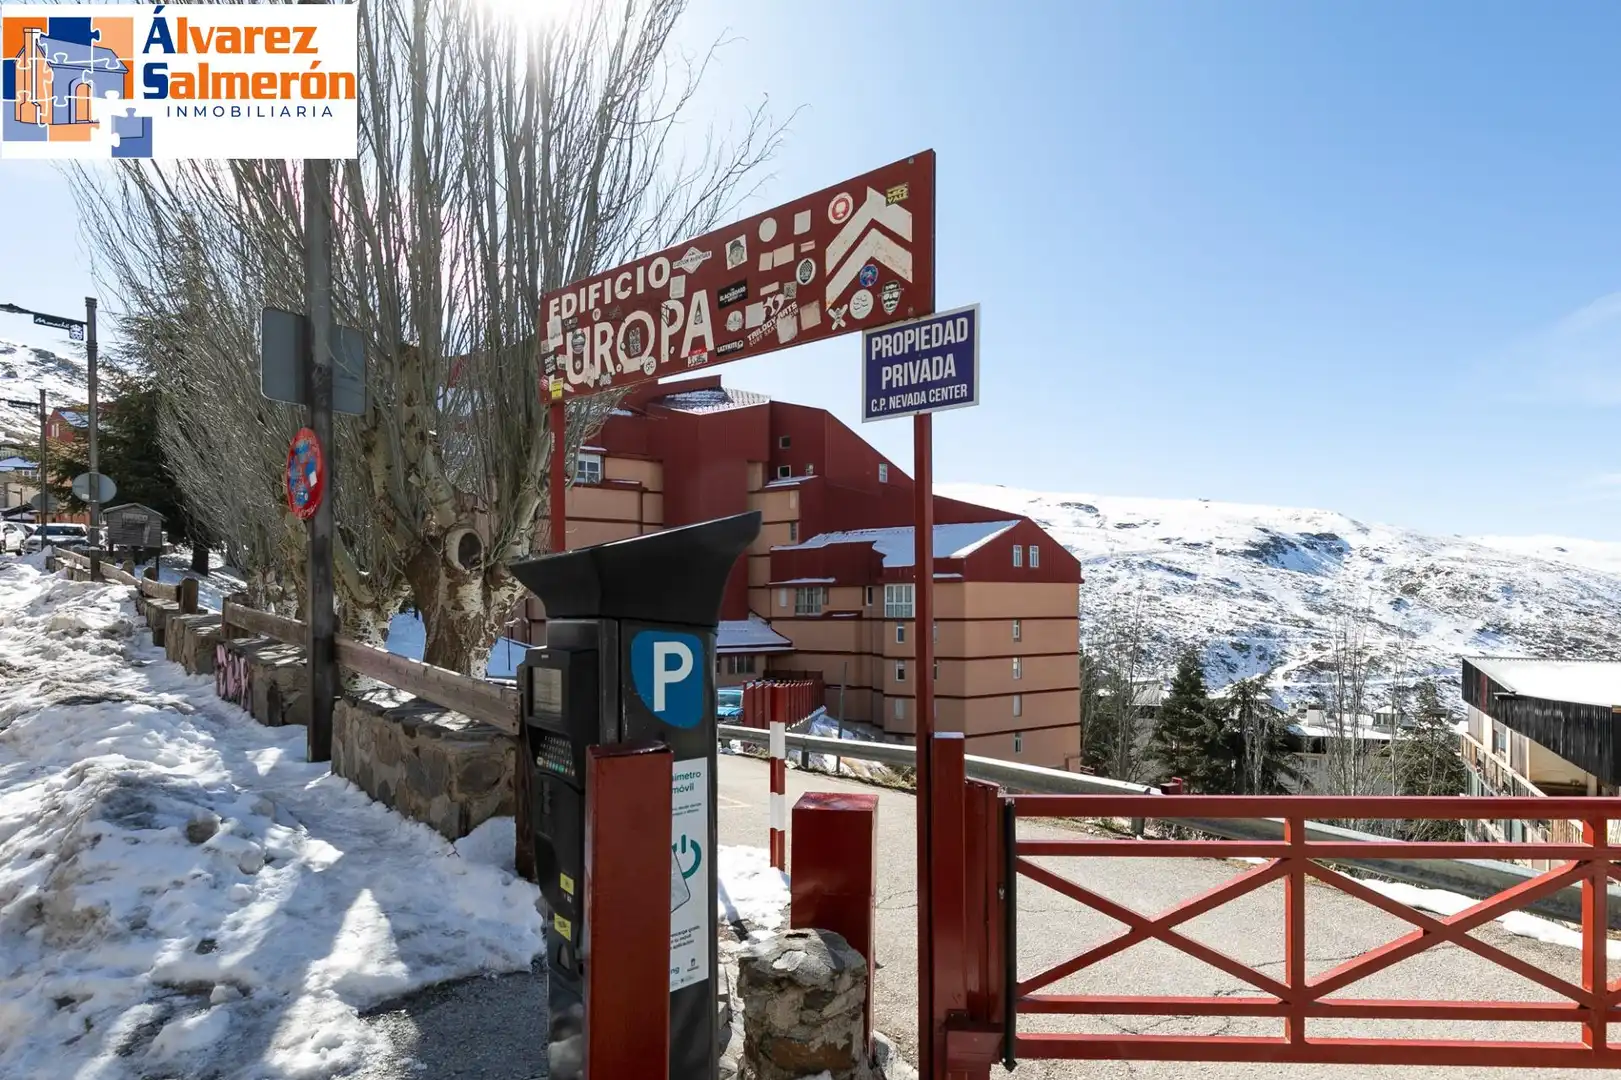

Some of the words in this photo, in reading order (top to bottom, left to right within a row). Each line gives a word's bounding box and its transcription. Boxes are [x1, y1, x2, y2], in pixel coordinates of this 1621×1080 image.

[549, 256, 671, 322] EDIFICIO
[547, 289, 715, 393] UROPA
[871, 316, 968, 361] PROPIEDAD
[871, 397, 887, 413] C.P.
[889, 390, 927, 410] NEVADA
[929, 383, 968, 403] CENTER
[881, 353, 957, 390] PRIVADA
[653, 641, 694, 713] P
